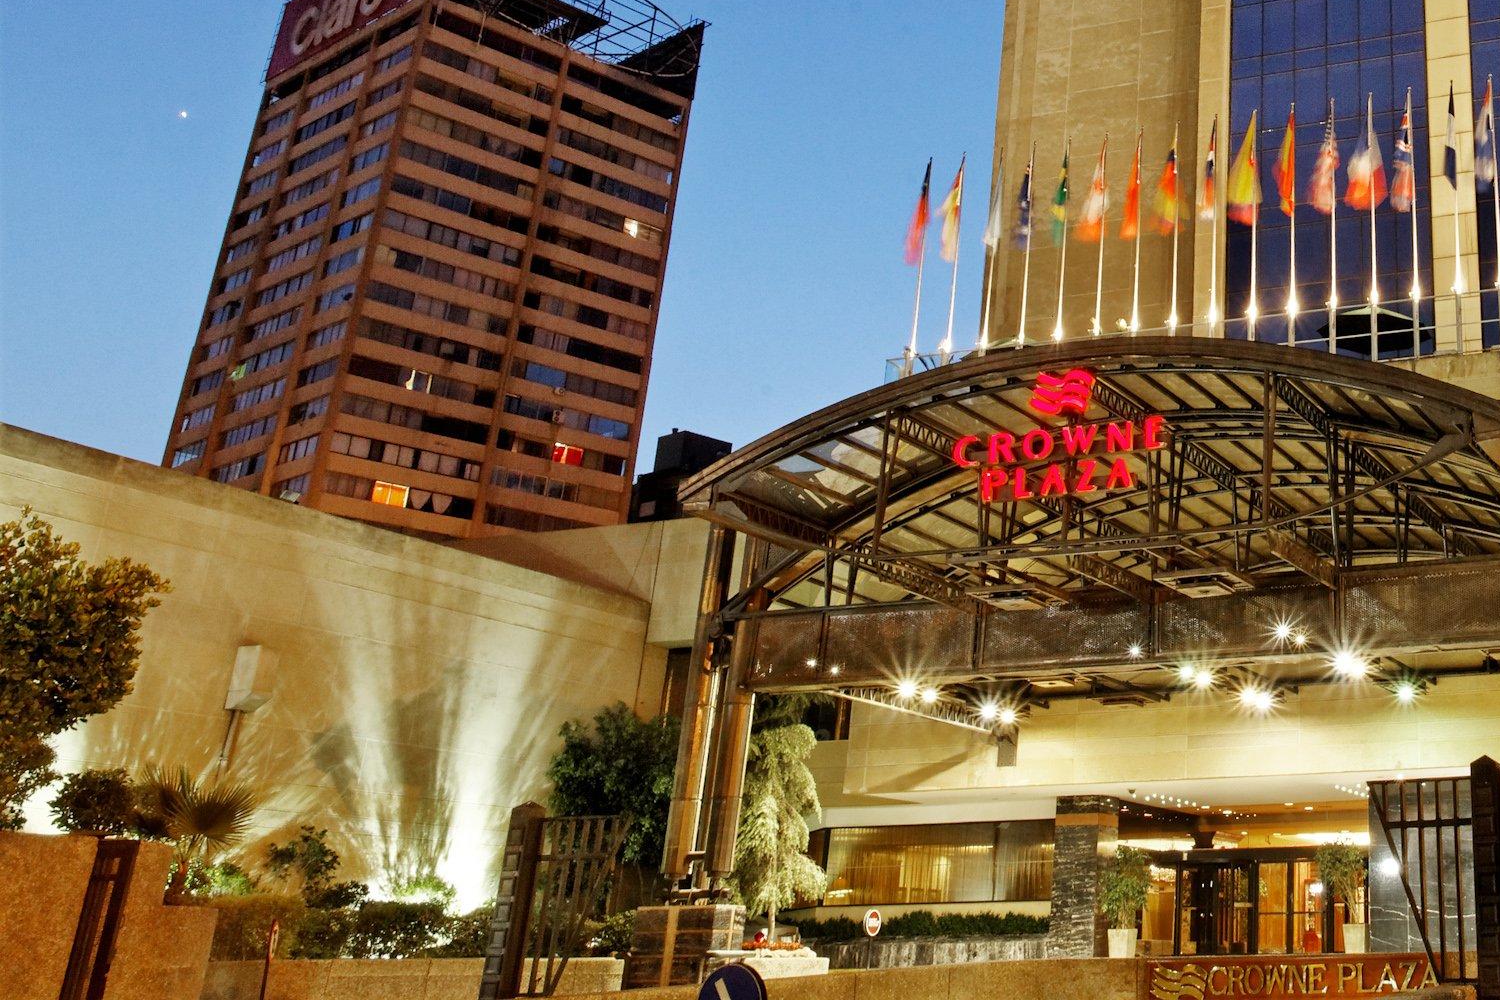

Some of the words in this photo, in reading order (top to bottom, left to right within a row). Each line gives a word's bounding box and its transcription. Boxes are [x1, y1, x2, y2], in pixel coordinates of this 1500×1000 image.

[952, 415, 1168, 467] CROWNE
[981, 457, 1134, 503] PLAZA
[1207, 962, 1327, 996] CROWNE
[1337, 959, 1441, 994] PLAZA
